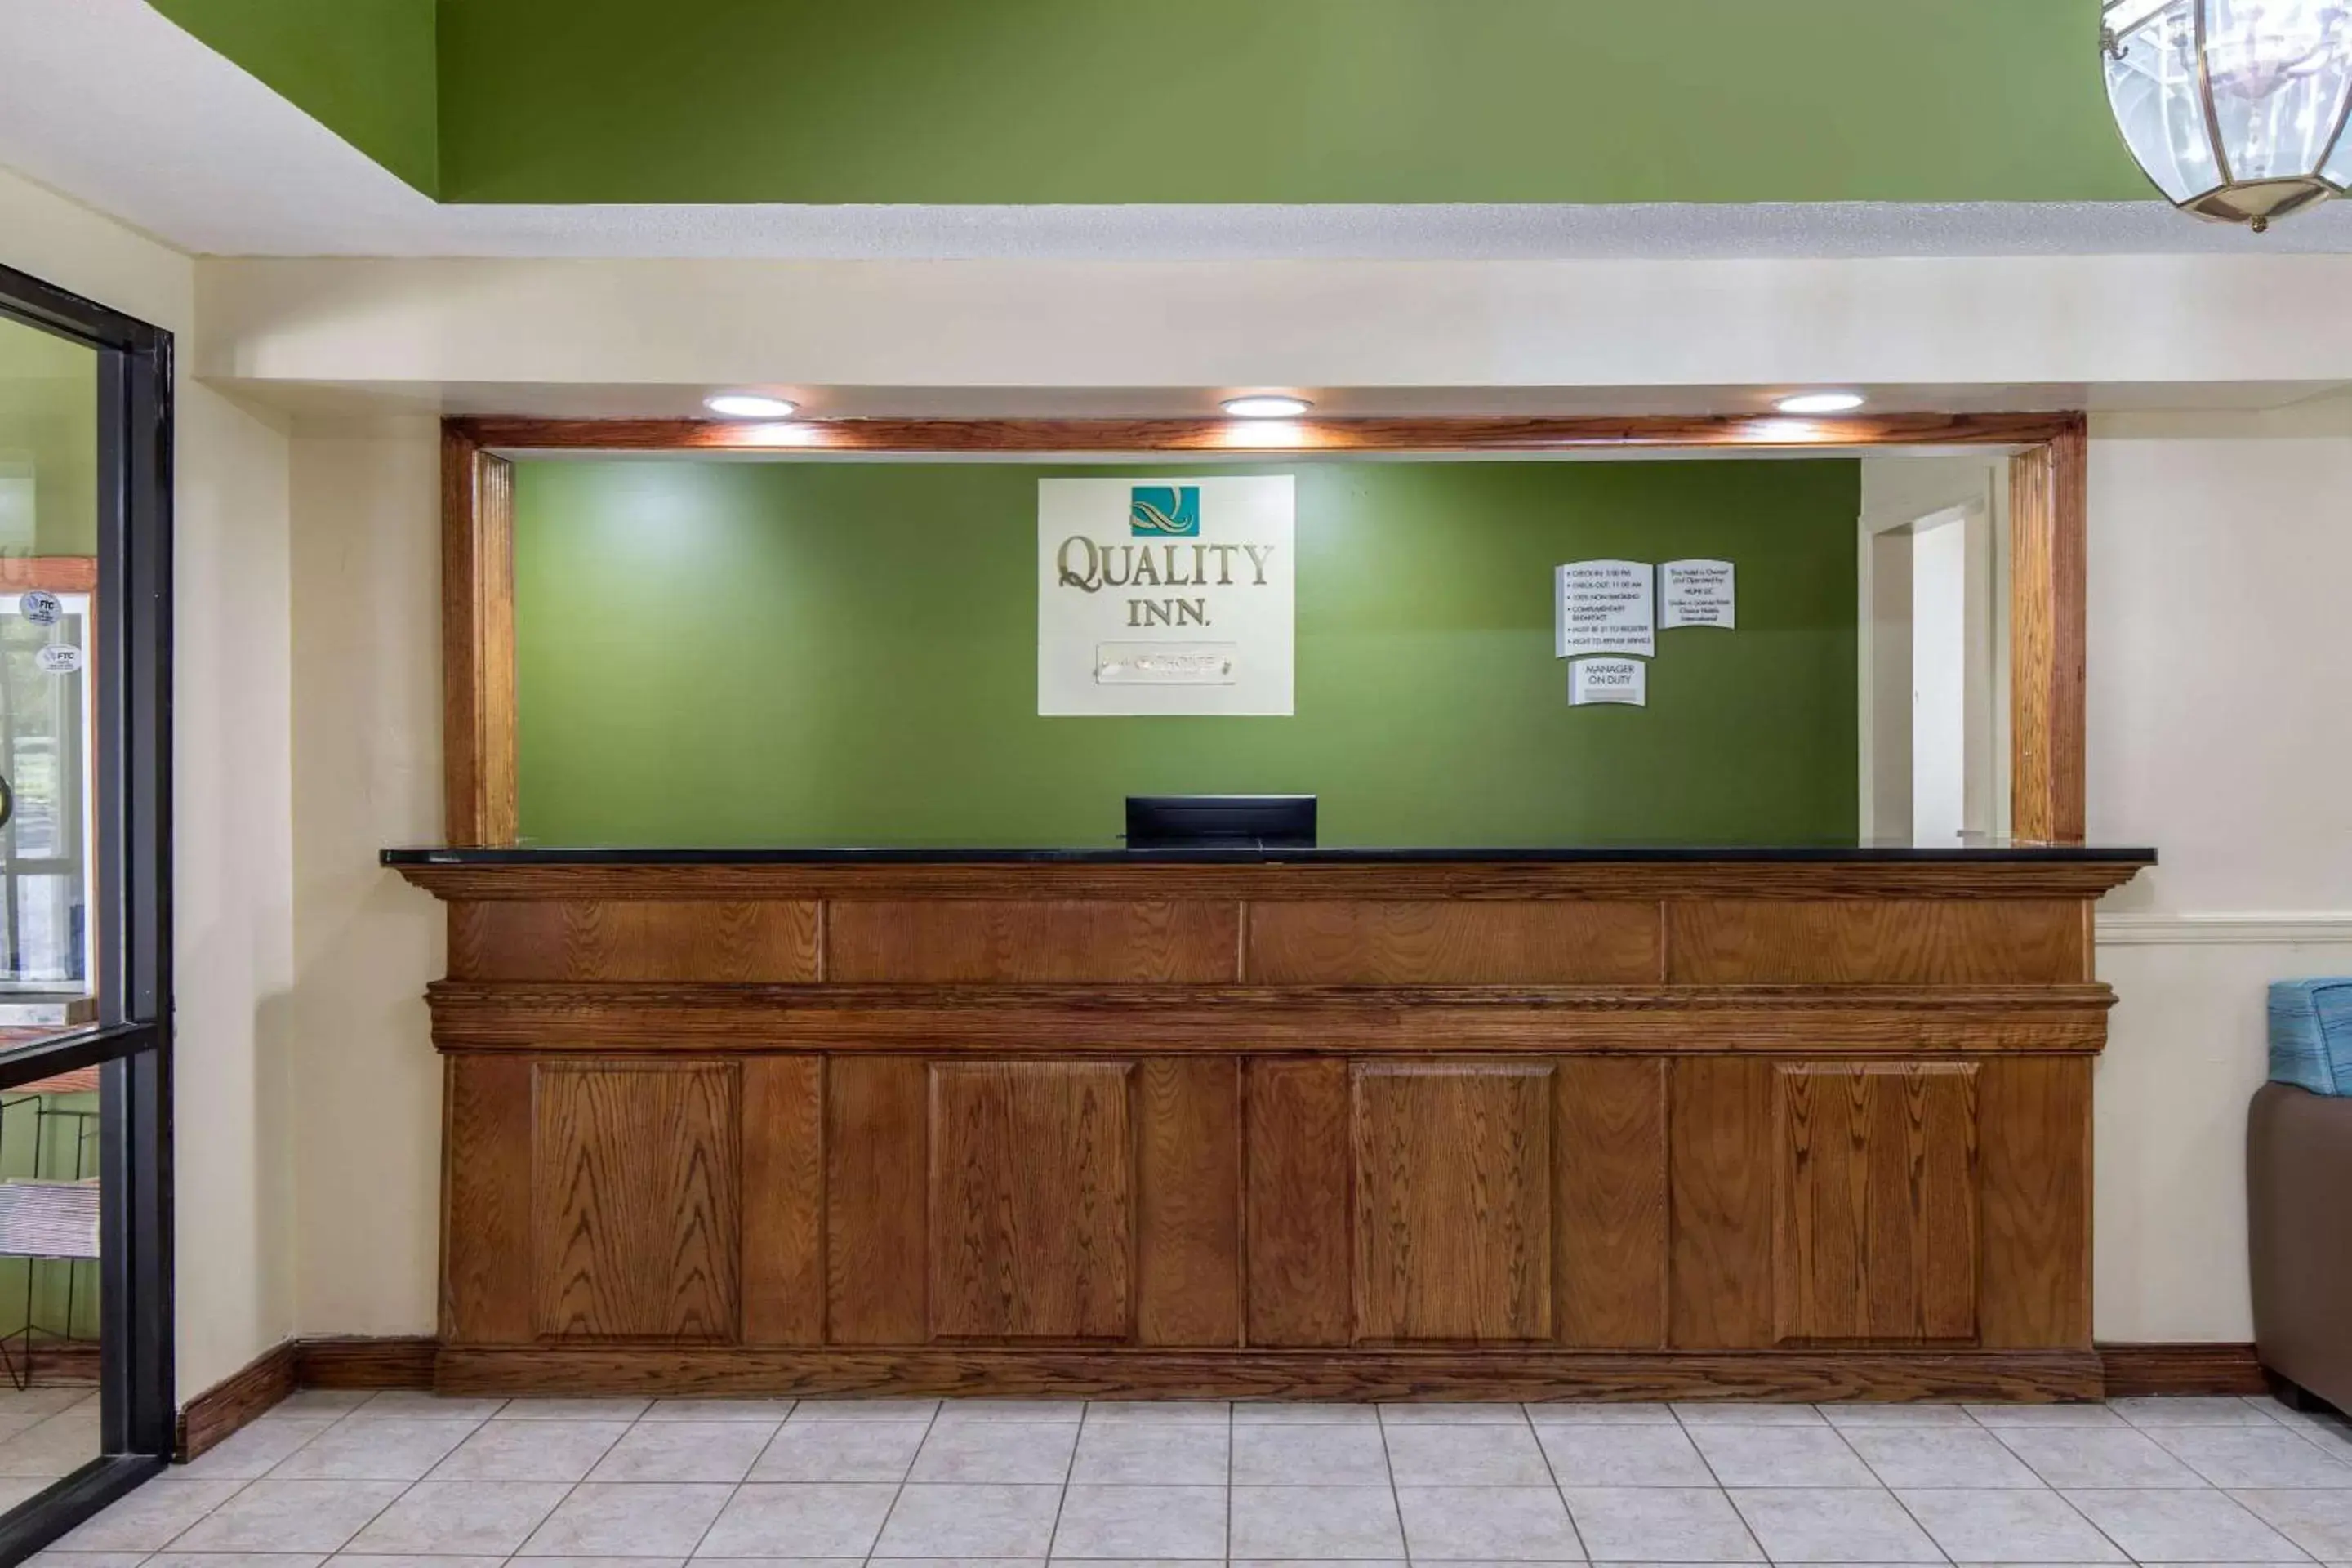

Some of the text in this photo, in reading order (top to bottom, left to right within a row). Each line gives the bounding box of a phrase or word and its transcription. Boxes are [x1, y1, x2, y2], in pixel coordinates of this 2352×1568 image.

[1057, 535, 1275, 593] QUALITY
[39, 600, 55, 611] FTC
[58, 651, 74, 660] FTC
[1585, 664, 1635, 675] MANAGER
[1588, 675, 1632, 684] ON DUTY
